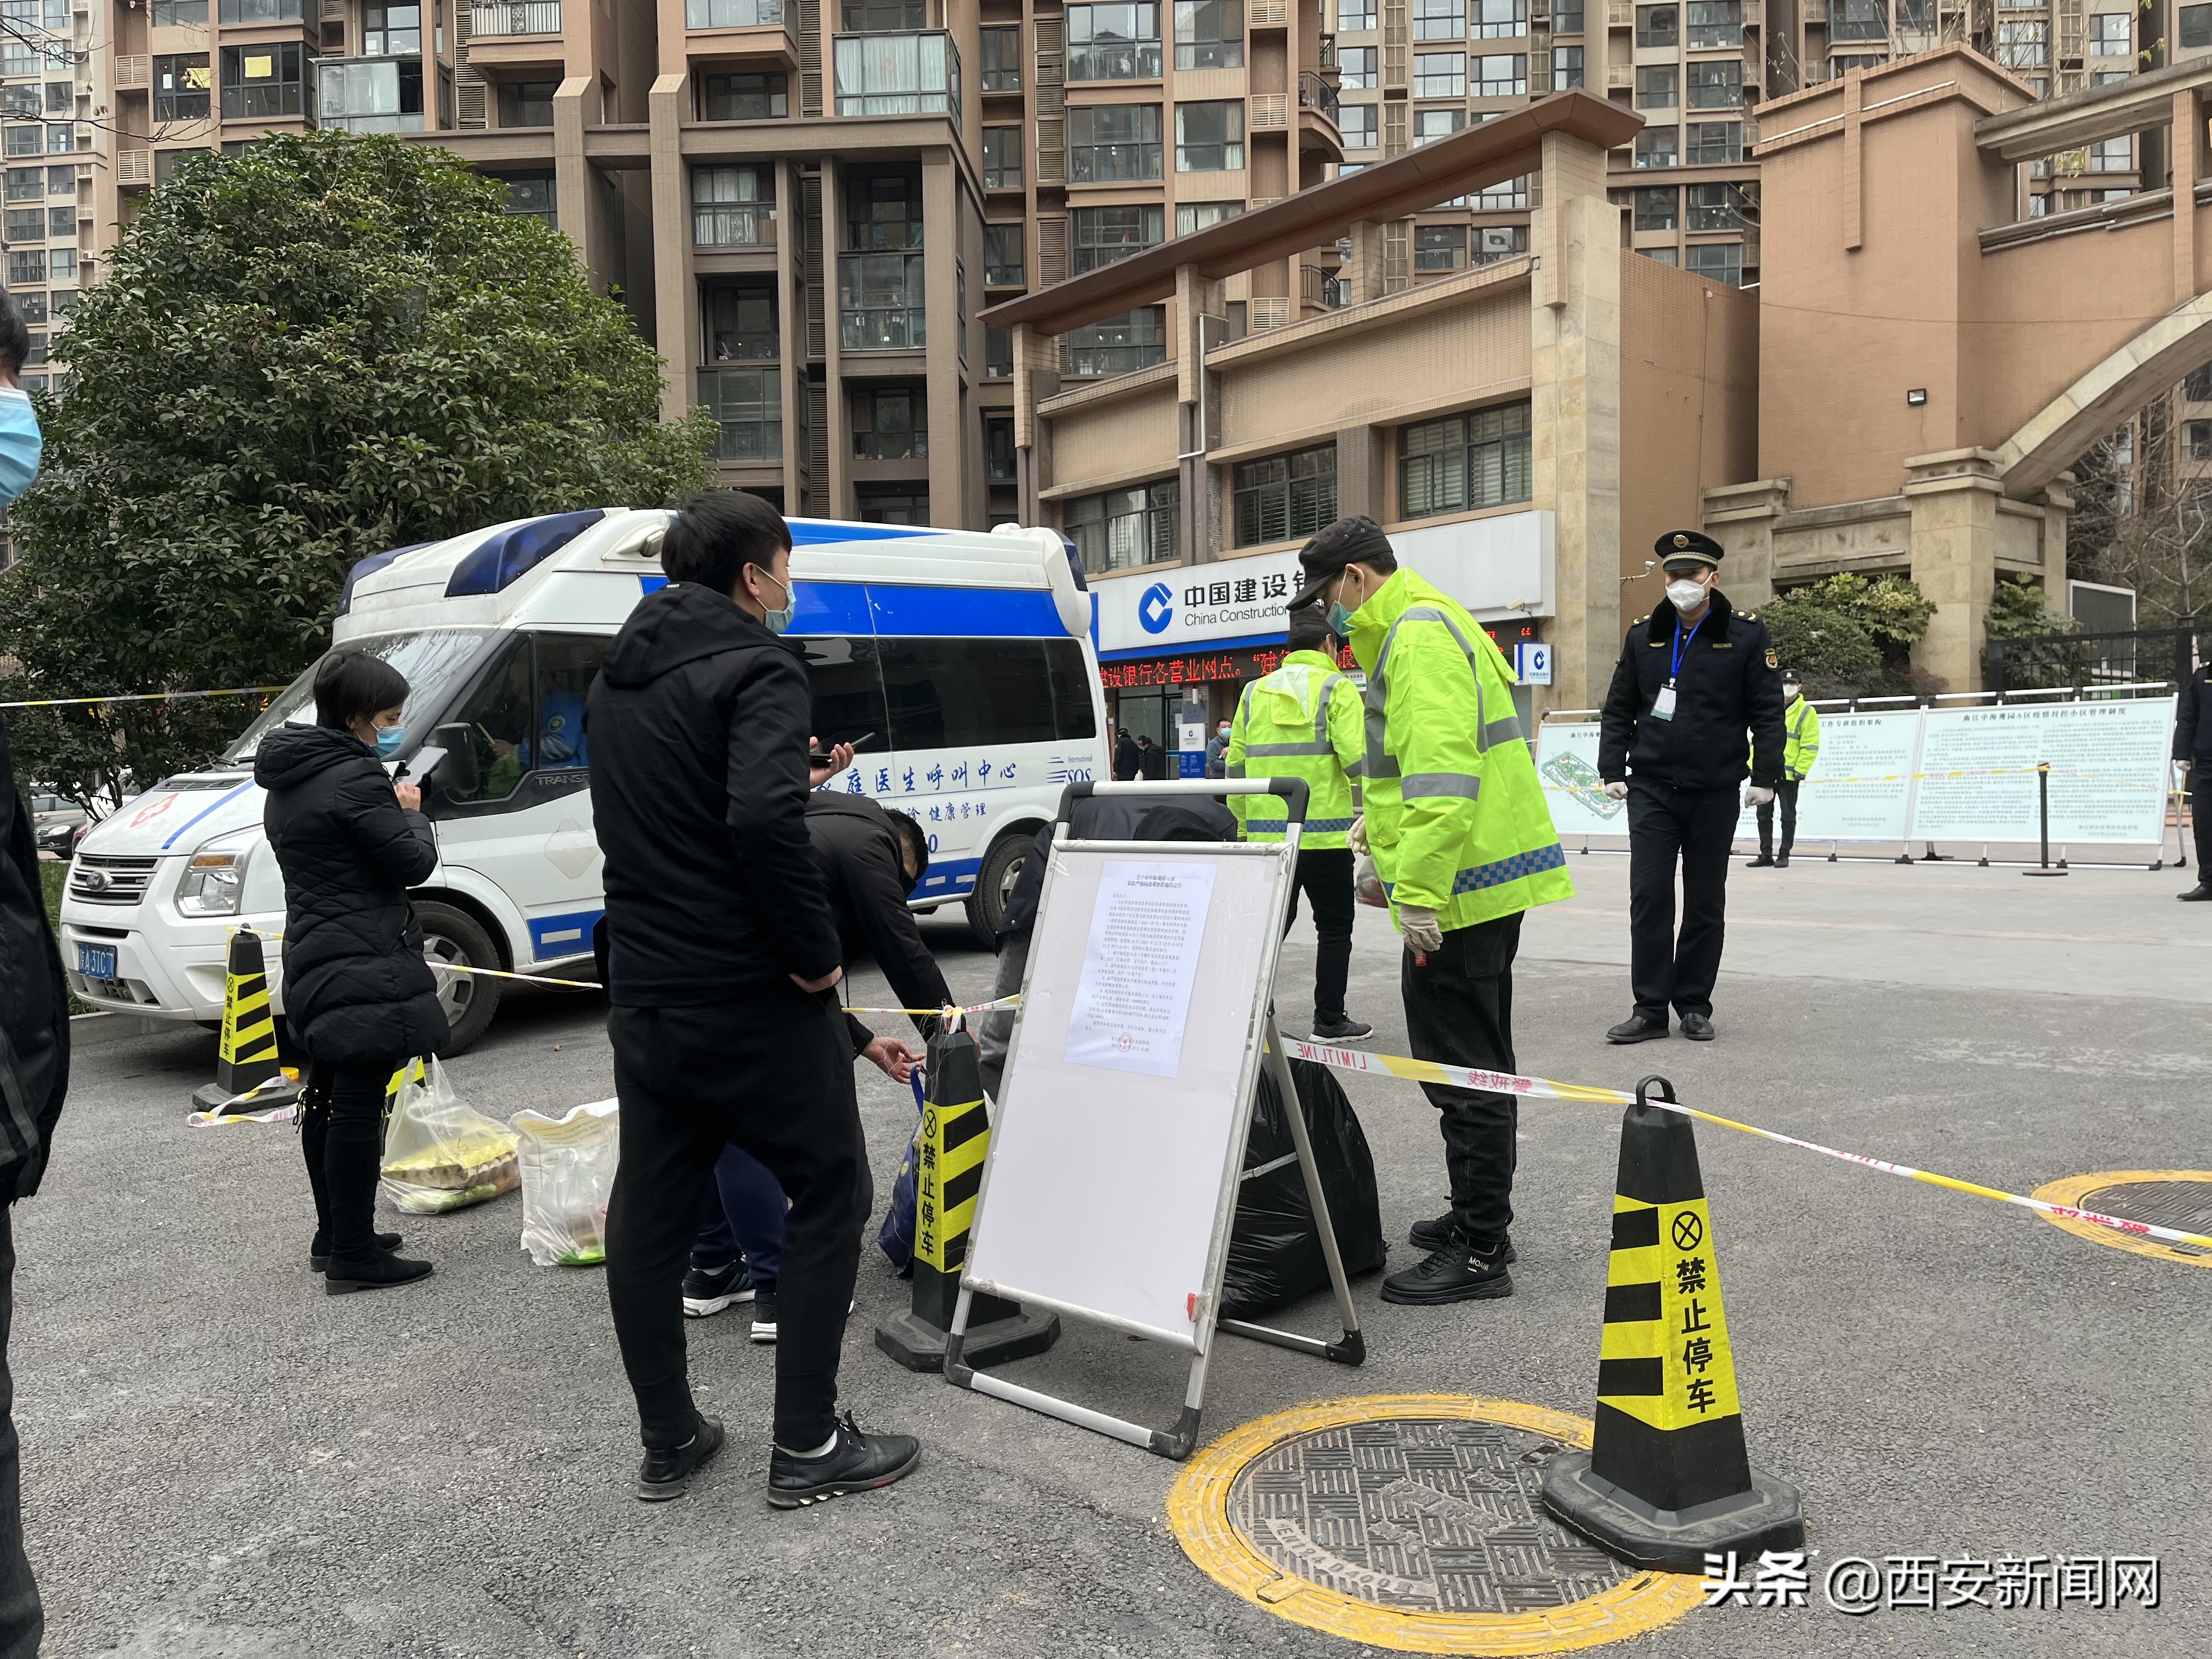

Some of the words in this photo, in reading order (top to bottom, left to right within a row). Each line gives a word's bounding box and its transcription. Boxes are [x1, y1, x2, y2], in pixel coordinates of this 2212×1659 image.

[1185, 612, 1217, 626] China
[1820, 719, 1882, 728] 工作专班组织架构
[1068, 755, 1092, 763] International
[816, 759, 1017, 795] 庭医生呼叫中心
[1068, 768, 1091, 783] SOS
[929, 802, 986, 822] 健康管理
[921, 1142, 936, 1258] 禁止停车
[1676, 1259, 1716, 1414] 禁止停车
